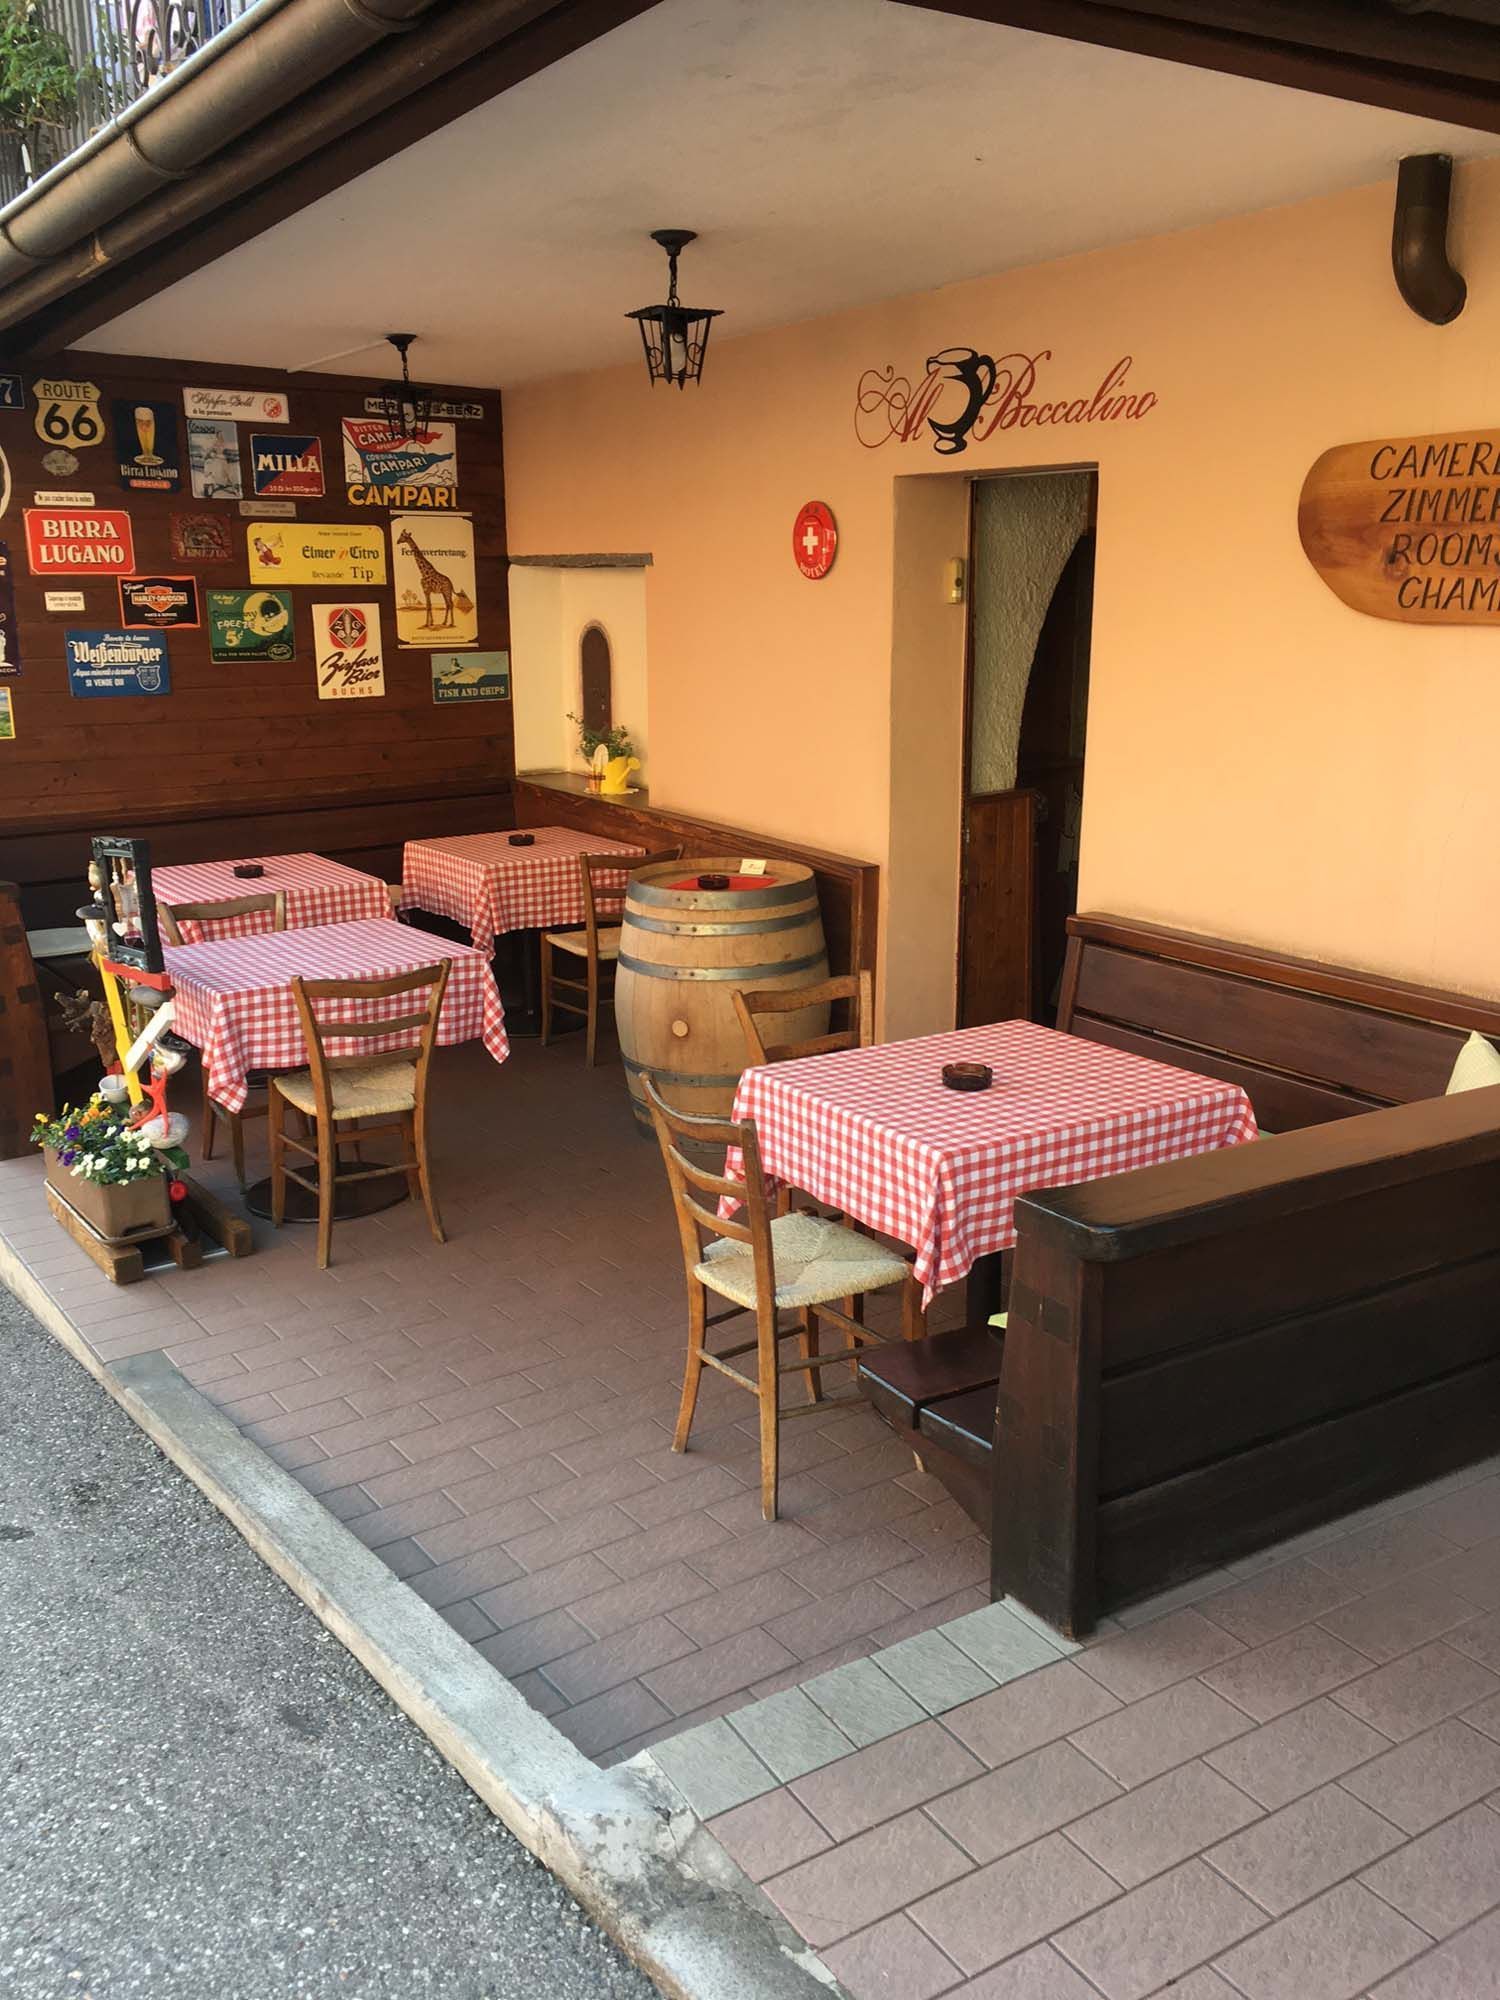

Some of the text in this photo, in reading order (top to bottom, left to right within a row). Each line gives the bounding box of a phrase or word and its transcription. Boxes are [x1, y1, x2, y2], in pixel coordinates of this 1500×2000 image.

[43, 383, 92, 399] ROUTE
[972, 350, 1158, 442] Boccalino
[44, 403, 98, 441] 66
[257, 454, 321, 472] MILLA
[371, 456, 428, 476] CAMPARI
[347, 484, 457, 507] CAMPARI
[42, 519, 119, 538] BIRRA
[40, 544, 125, 564] LUGANO
[302, 545, 336, 559] Elmer
[1388, 532, 1500, 566] ROOM
[349, 566, 374, 583] Tip
[1398, 576, 1500, 612] CHAM
[341, 669, 380, 687] Bier
[332, 686, 373, 696] BUCHS
[439, 686, 505, 698] FISH AND CHIPS
